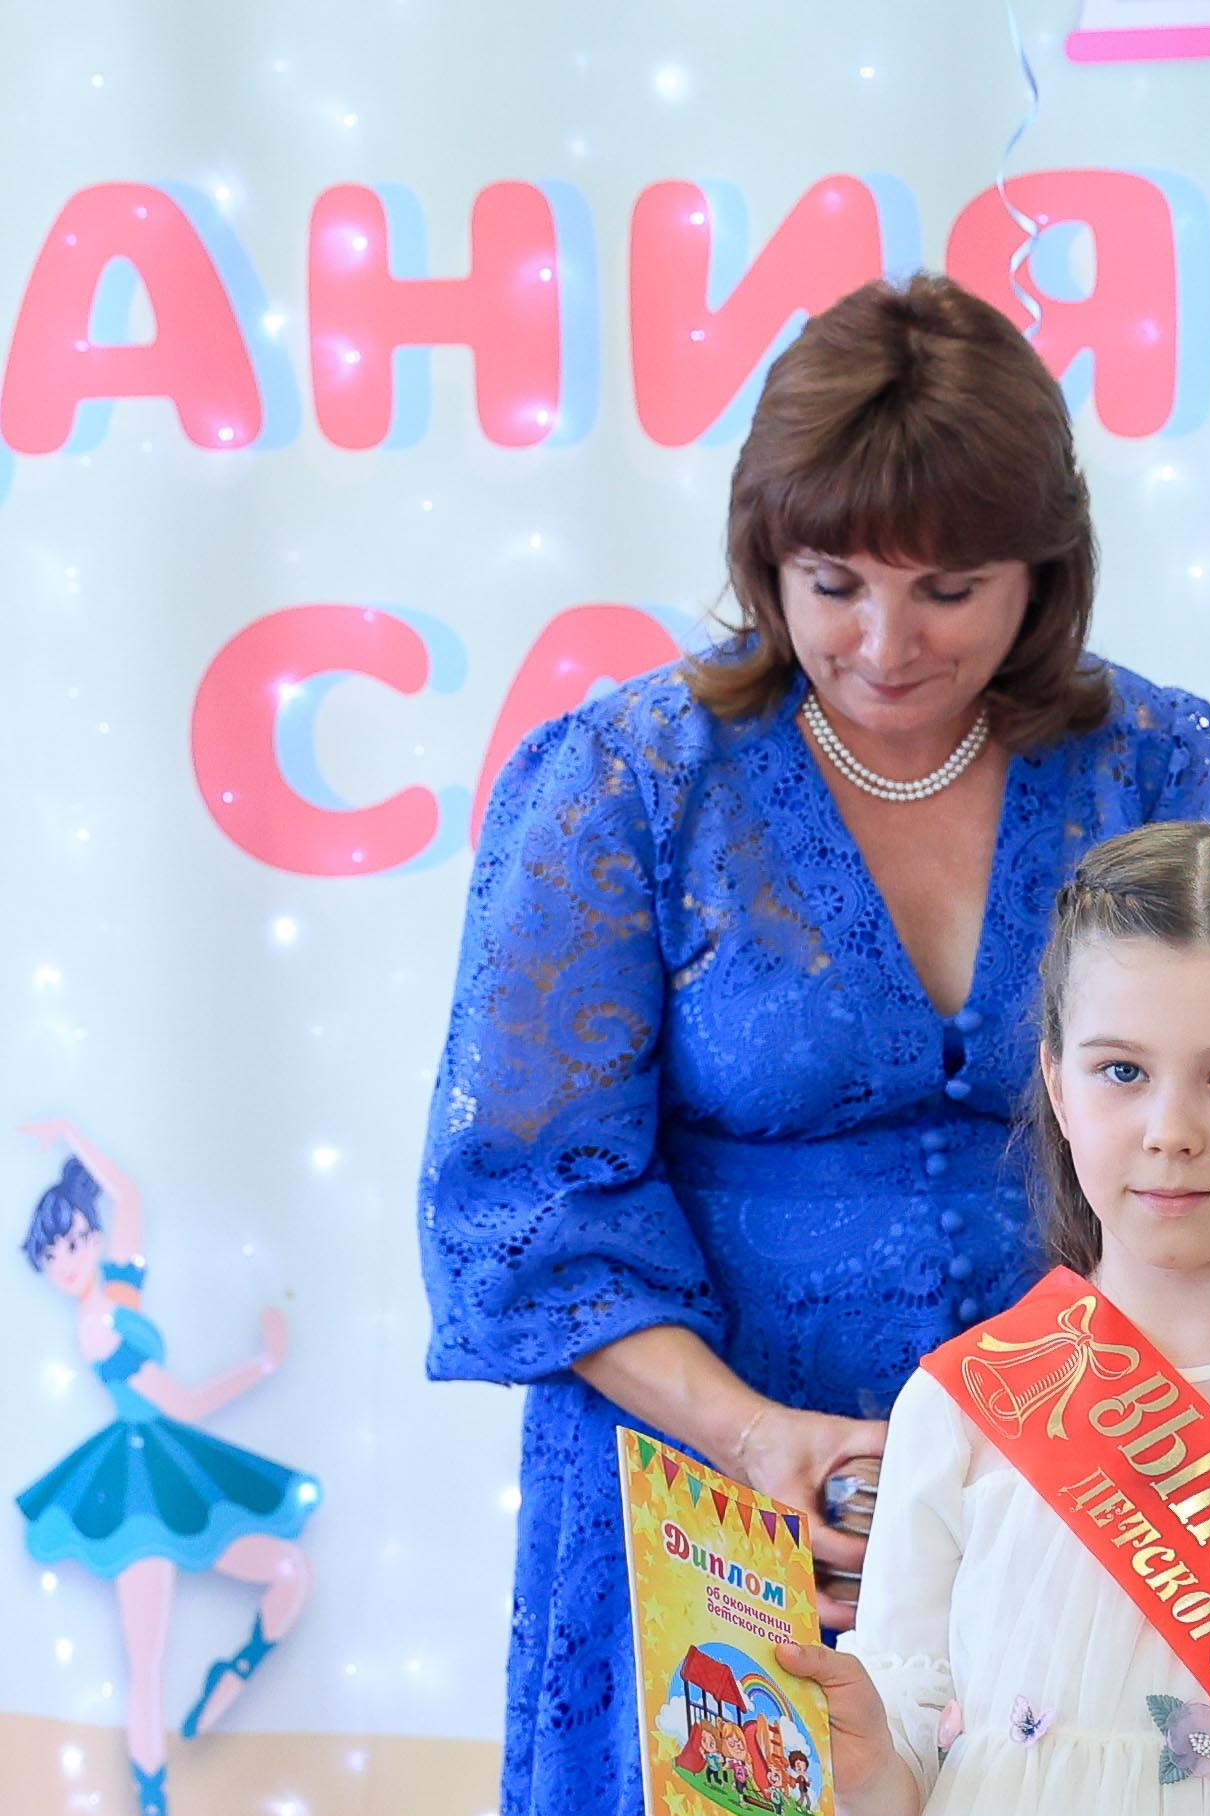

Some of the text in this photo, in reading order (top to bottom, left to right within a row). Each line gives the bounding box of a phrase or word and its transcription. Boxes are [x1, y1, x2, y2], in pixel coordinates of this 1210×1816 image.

[664, 1522, 785, 1608] Диплом
[706, 1586, 791, 1634] об окончании
[707, 1598, 766, 1638] детского
